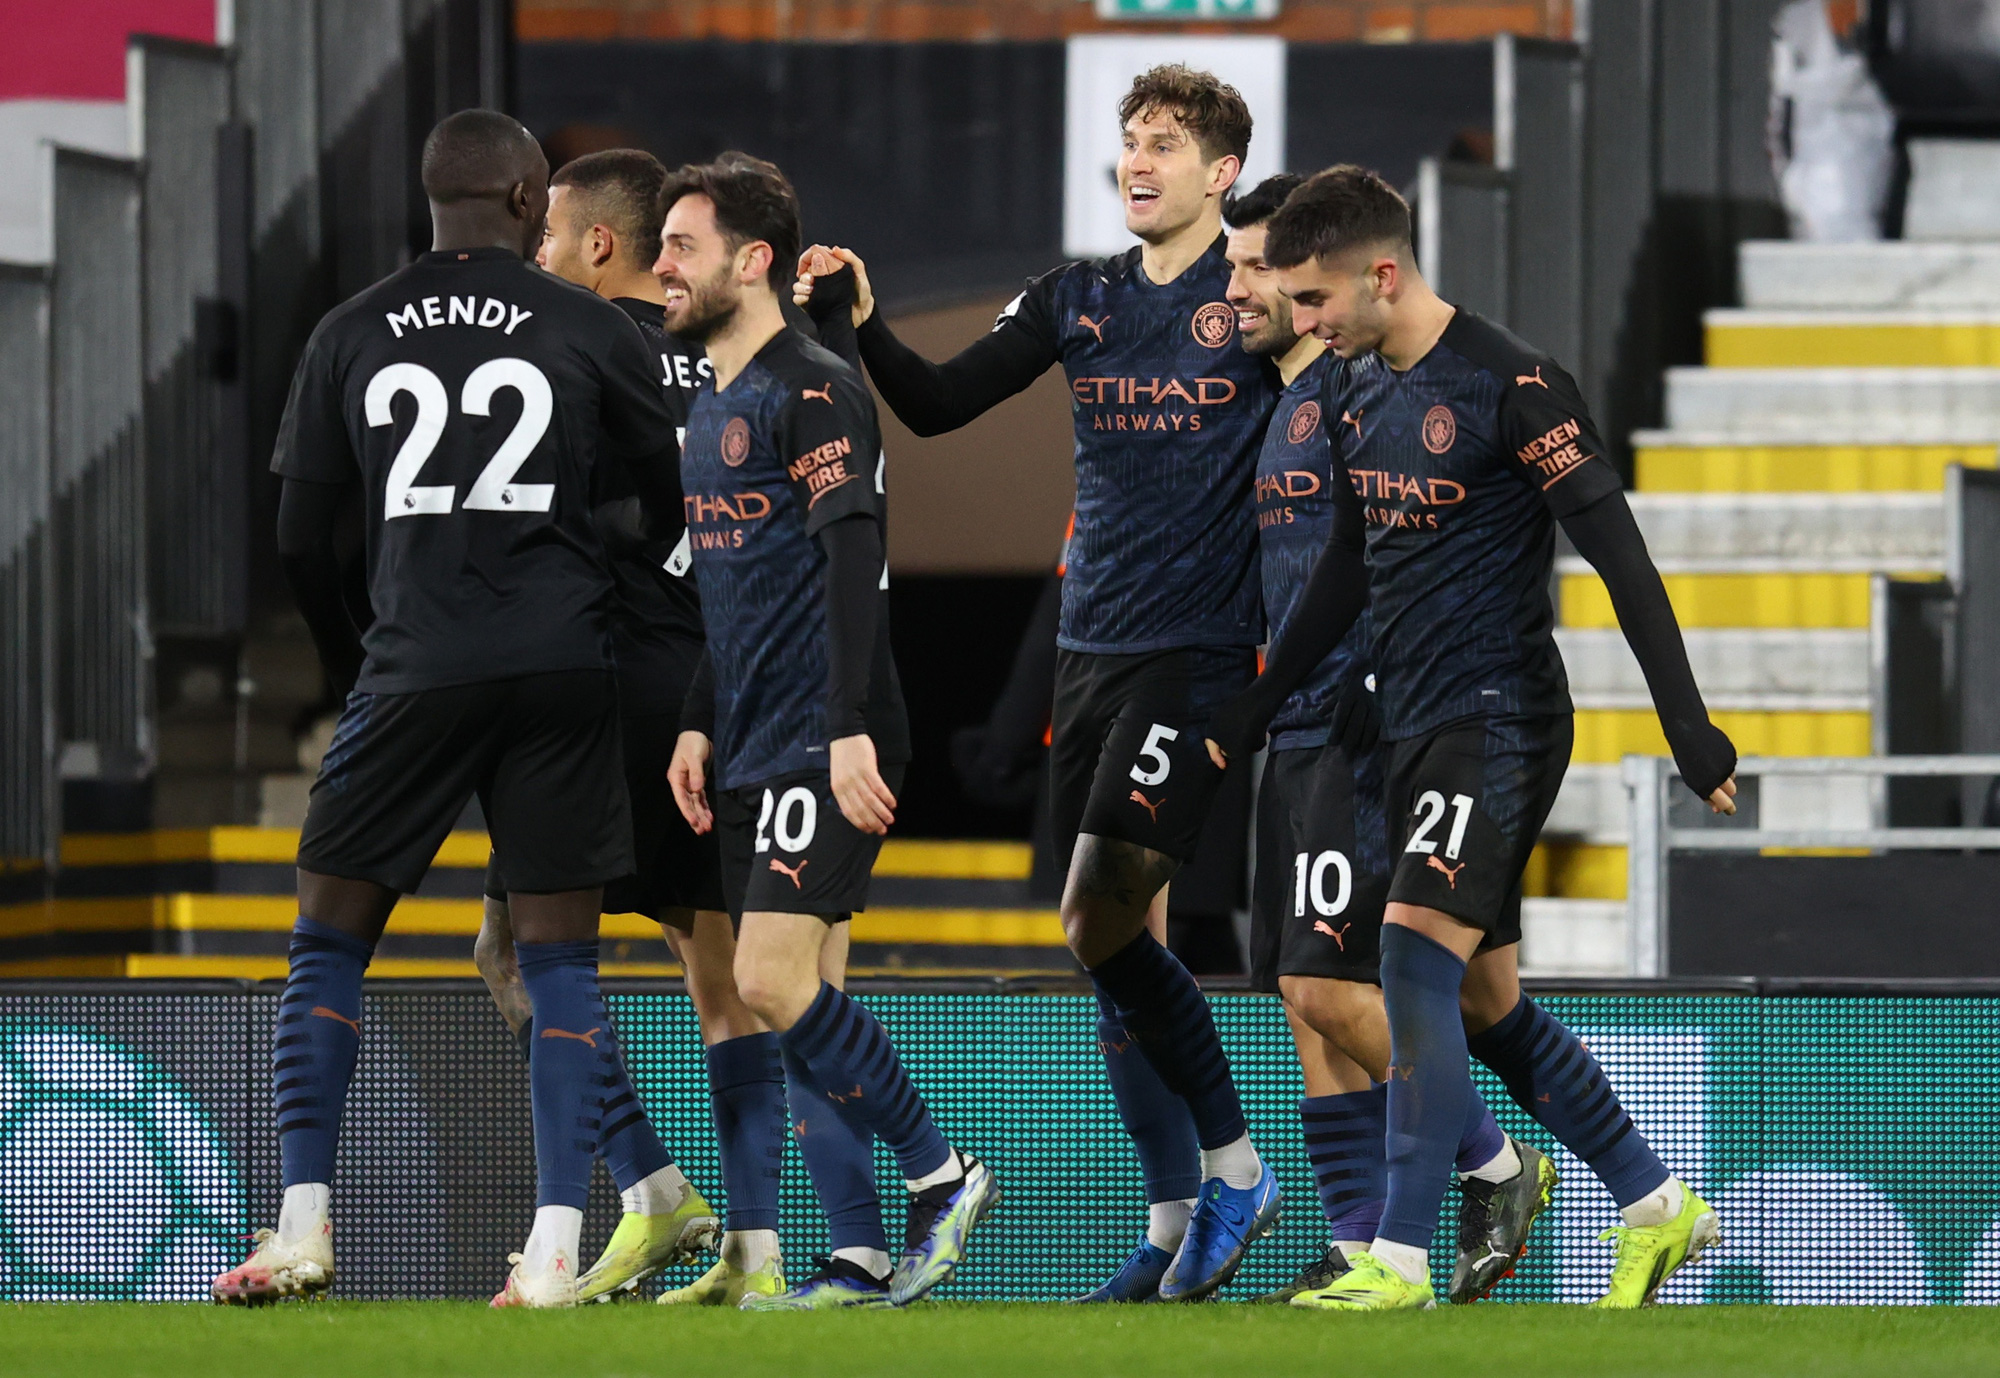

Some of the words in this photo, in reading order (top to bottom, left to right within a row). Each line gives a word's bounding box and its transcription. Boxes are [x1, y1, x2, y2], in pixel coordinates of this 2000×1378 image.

[386, 296, 533, 338] MENDY
[1073, 377, 1237, 405] ETIHAD
[364, 357, 556, 521] 22
[1093, 414, 1202, 432] AIRWAYS
[1516, 418, 1581, 465] NEXEN
[787, 436, 852, 482] NEXEN
[806, 460, 847, 494] TIRE
[1536, 442, 1582, 476] TIRE
[1129, 723, 1179, 786] 5
[755, 786, 818, 854] 20
[1404, 790, 1474, 860] 21
[1295, 850, 1352, 917] 10
